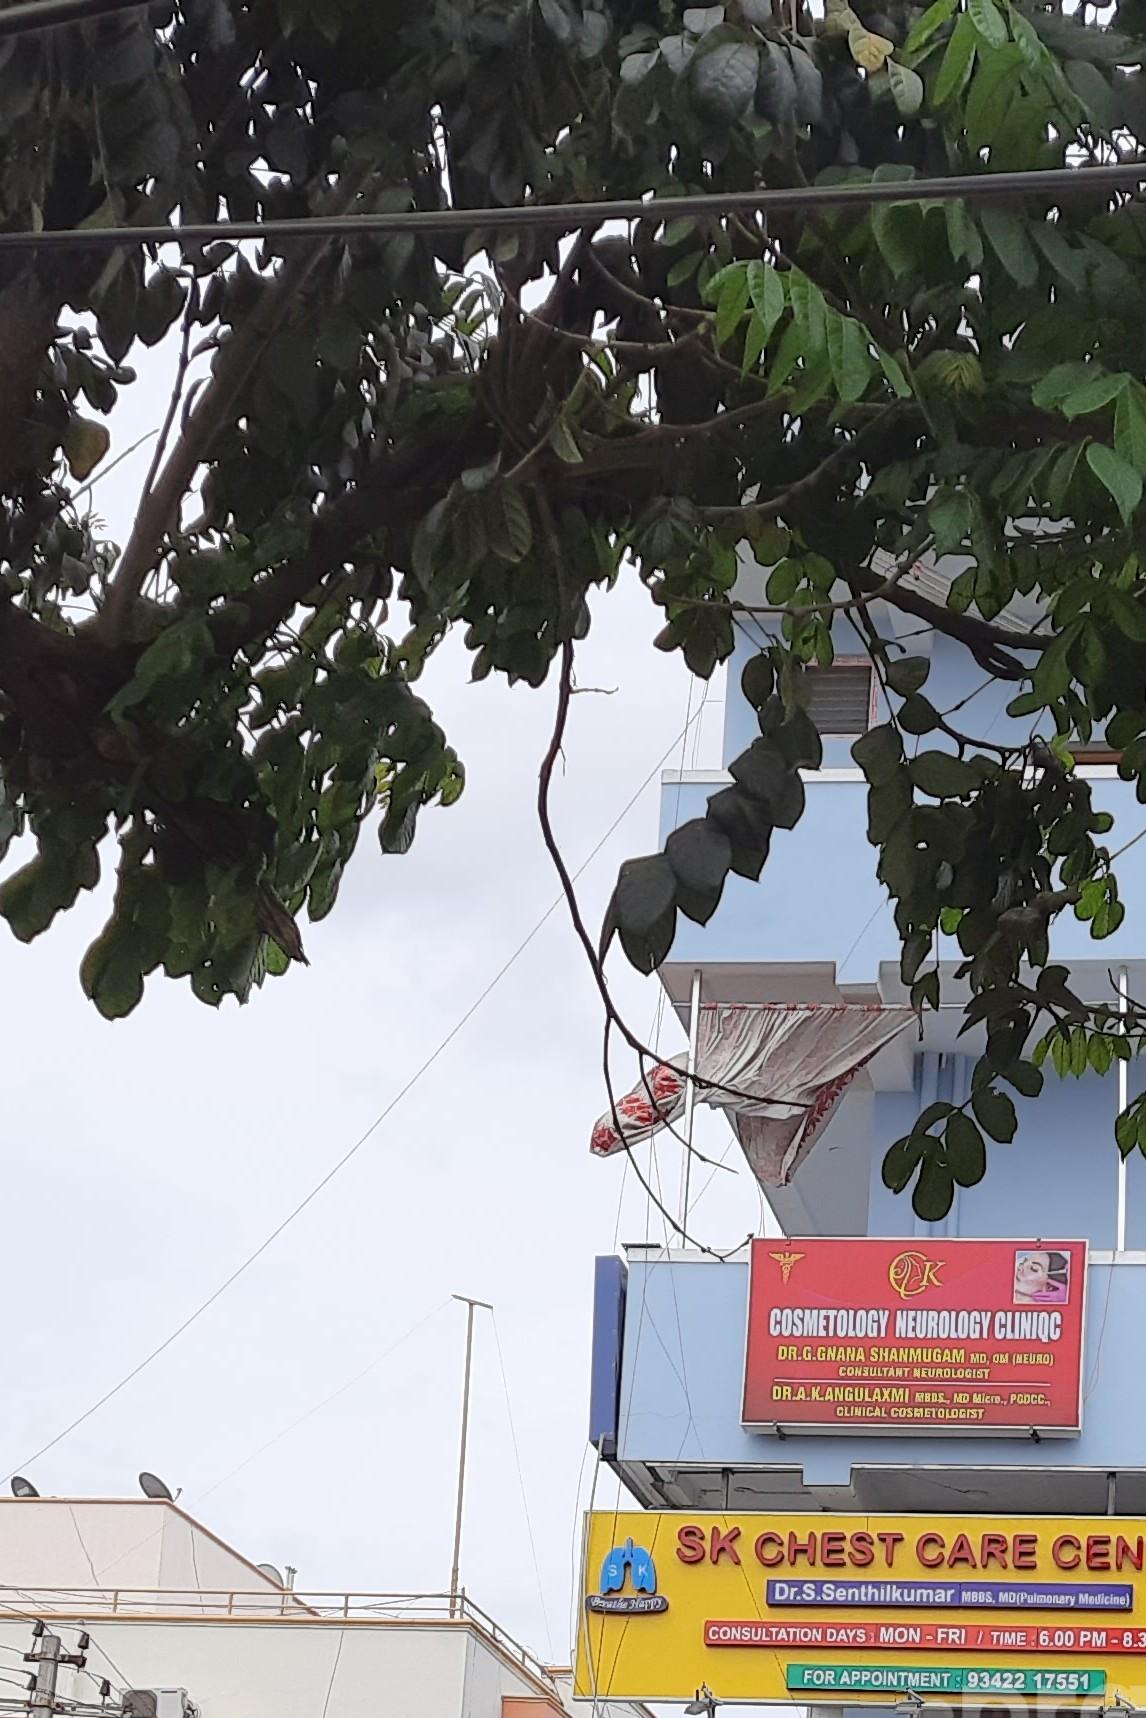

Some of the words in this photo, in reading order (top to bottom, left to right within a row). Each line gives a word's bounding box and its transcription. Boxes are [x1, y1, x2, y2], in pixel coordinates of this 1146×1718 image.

[769, 1308, 889, 1338] COSMETOLOGY
[895, 1310, 992, 1340] NEUROLOGY
[994, 1311, 1062, 1343] CLINIQC
[777, 1345, 866, 1362] DR.G.GNANA
[869, 1347, 965, 1364] SHANMUGAM
[838, 1366, 911, 1378] CONSULTANT
[913, 1367, 991, 1380] NEUROLOGIST
[836, 1406, 888, 1418] CLINICAL
[890, 1407, 985, 1420] COSMETOLOGIST
[676, 1525, 742, 1566] SK
[755, 1531, 904, 1568] CHEST
[916, 1533, 1038, 1569] CARE
[628, 1597, 663, 1611] Happy
[774, 1583, 956, 1604] Dr.S.Senthilkumar
[708, 1626, 823, 1644] CONSULTATION
[826, 1627, 867, 1644] DAYS
[879, 1627, 921, 1644] MON
[937, 1628, 966, 1645] FRI
[990, 1631, 1027, 1648] TIME
[1039, 1630, 1075, 1648] 6.00
[1080, 1631, 1107, 1649] PM
[803, 1669, 836, 1686] FOR
[839, 1670, 951, 1688] APPOINTMENT
[967, 1671, 1026, 1690] 93422
[1033, 1673, 1090, 1690] 17551
